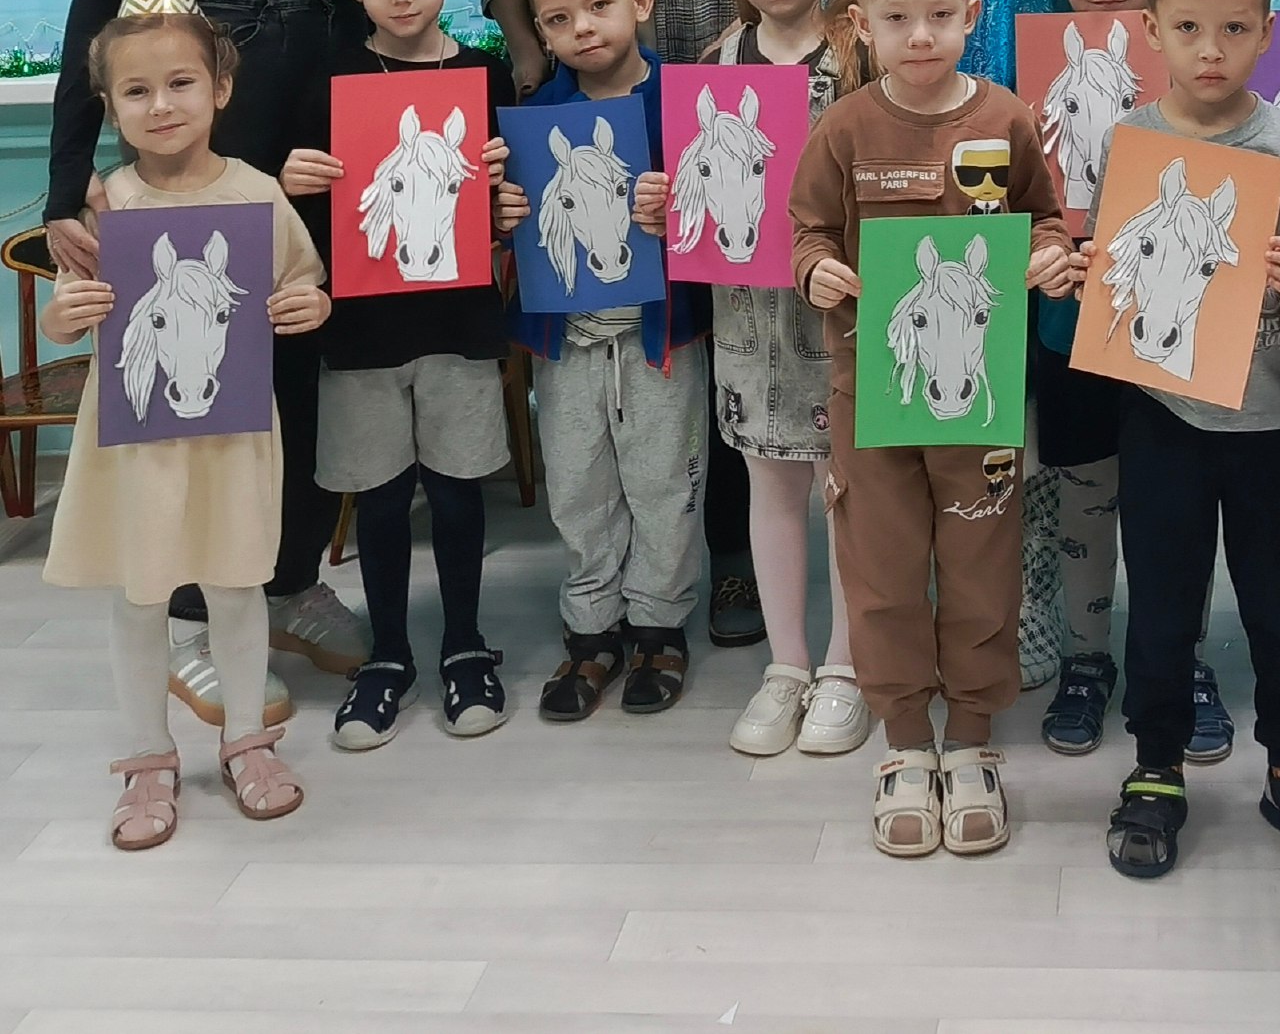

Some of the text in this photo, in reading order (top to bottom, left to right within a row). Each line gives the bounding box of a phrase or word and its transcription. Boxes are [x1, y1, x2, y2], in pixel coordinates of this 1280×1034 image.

[880, 170, 938, 181] LAGERFELD
[880, 179, 909, 190] PARIS
[687, 454, 700, 478] THE
[942, 483, 1014, 520] Karl
